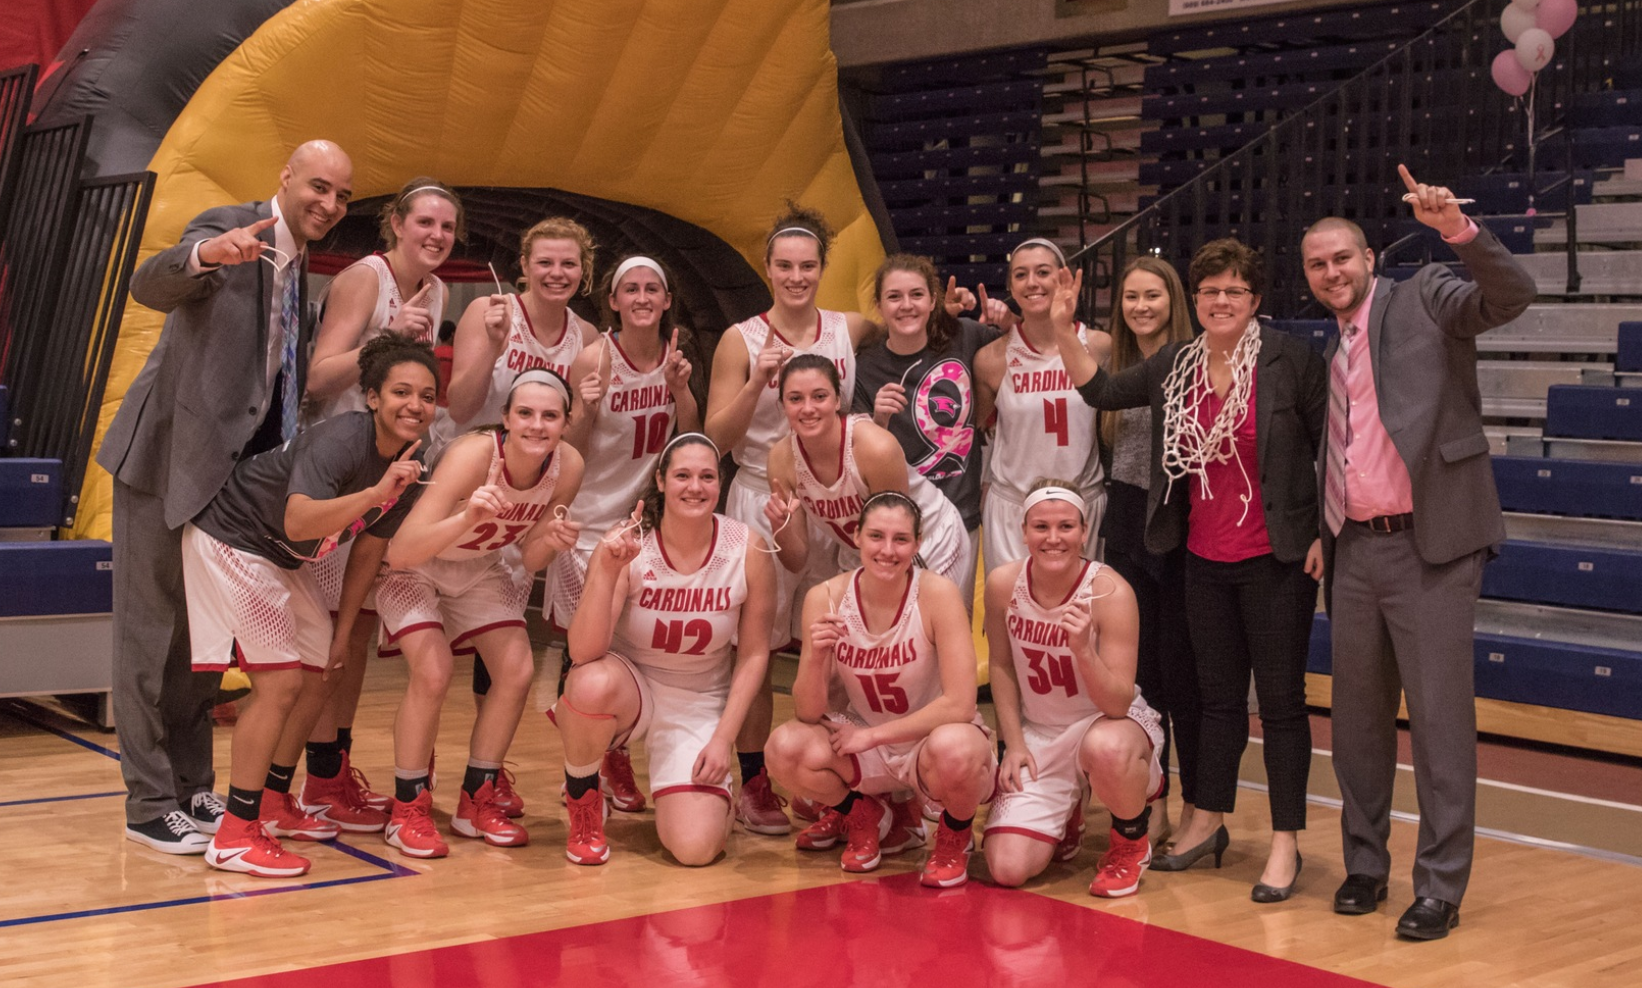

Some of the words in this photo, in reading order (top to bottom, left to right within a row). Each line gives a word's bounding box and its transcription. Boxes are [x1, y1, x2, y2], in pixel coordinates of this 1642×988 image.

[631, 412, 670, 460] 10
[1043, 397, 1069, 447] 4
[456, 521, 529, 551] 23
[638, 586, 732, 613] CARDINALS
[651, 617, 713, 656] 42
[837, 637, 917, 670] CARDINALS
[1021, 646, 1079, 698] 34
[854, 671, 909, 715] 15
